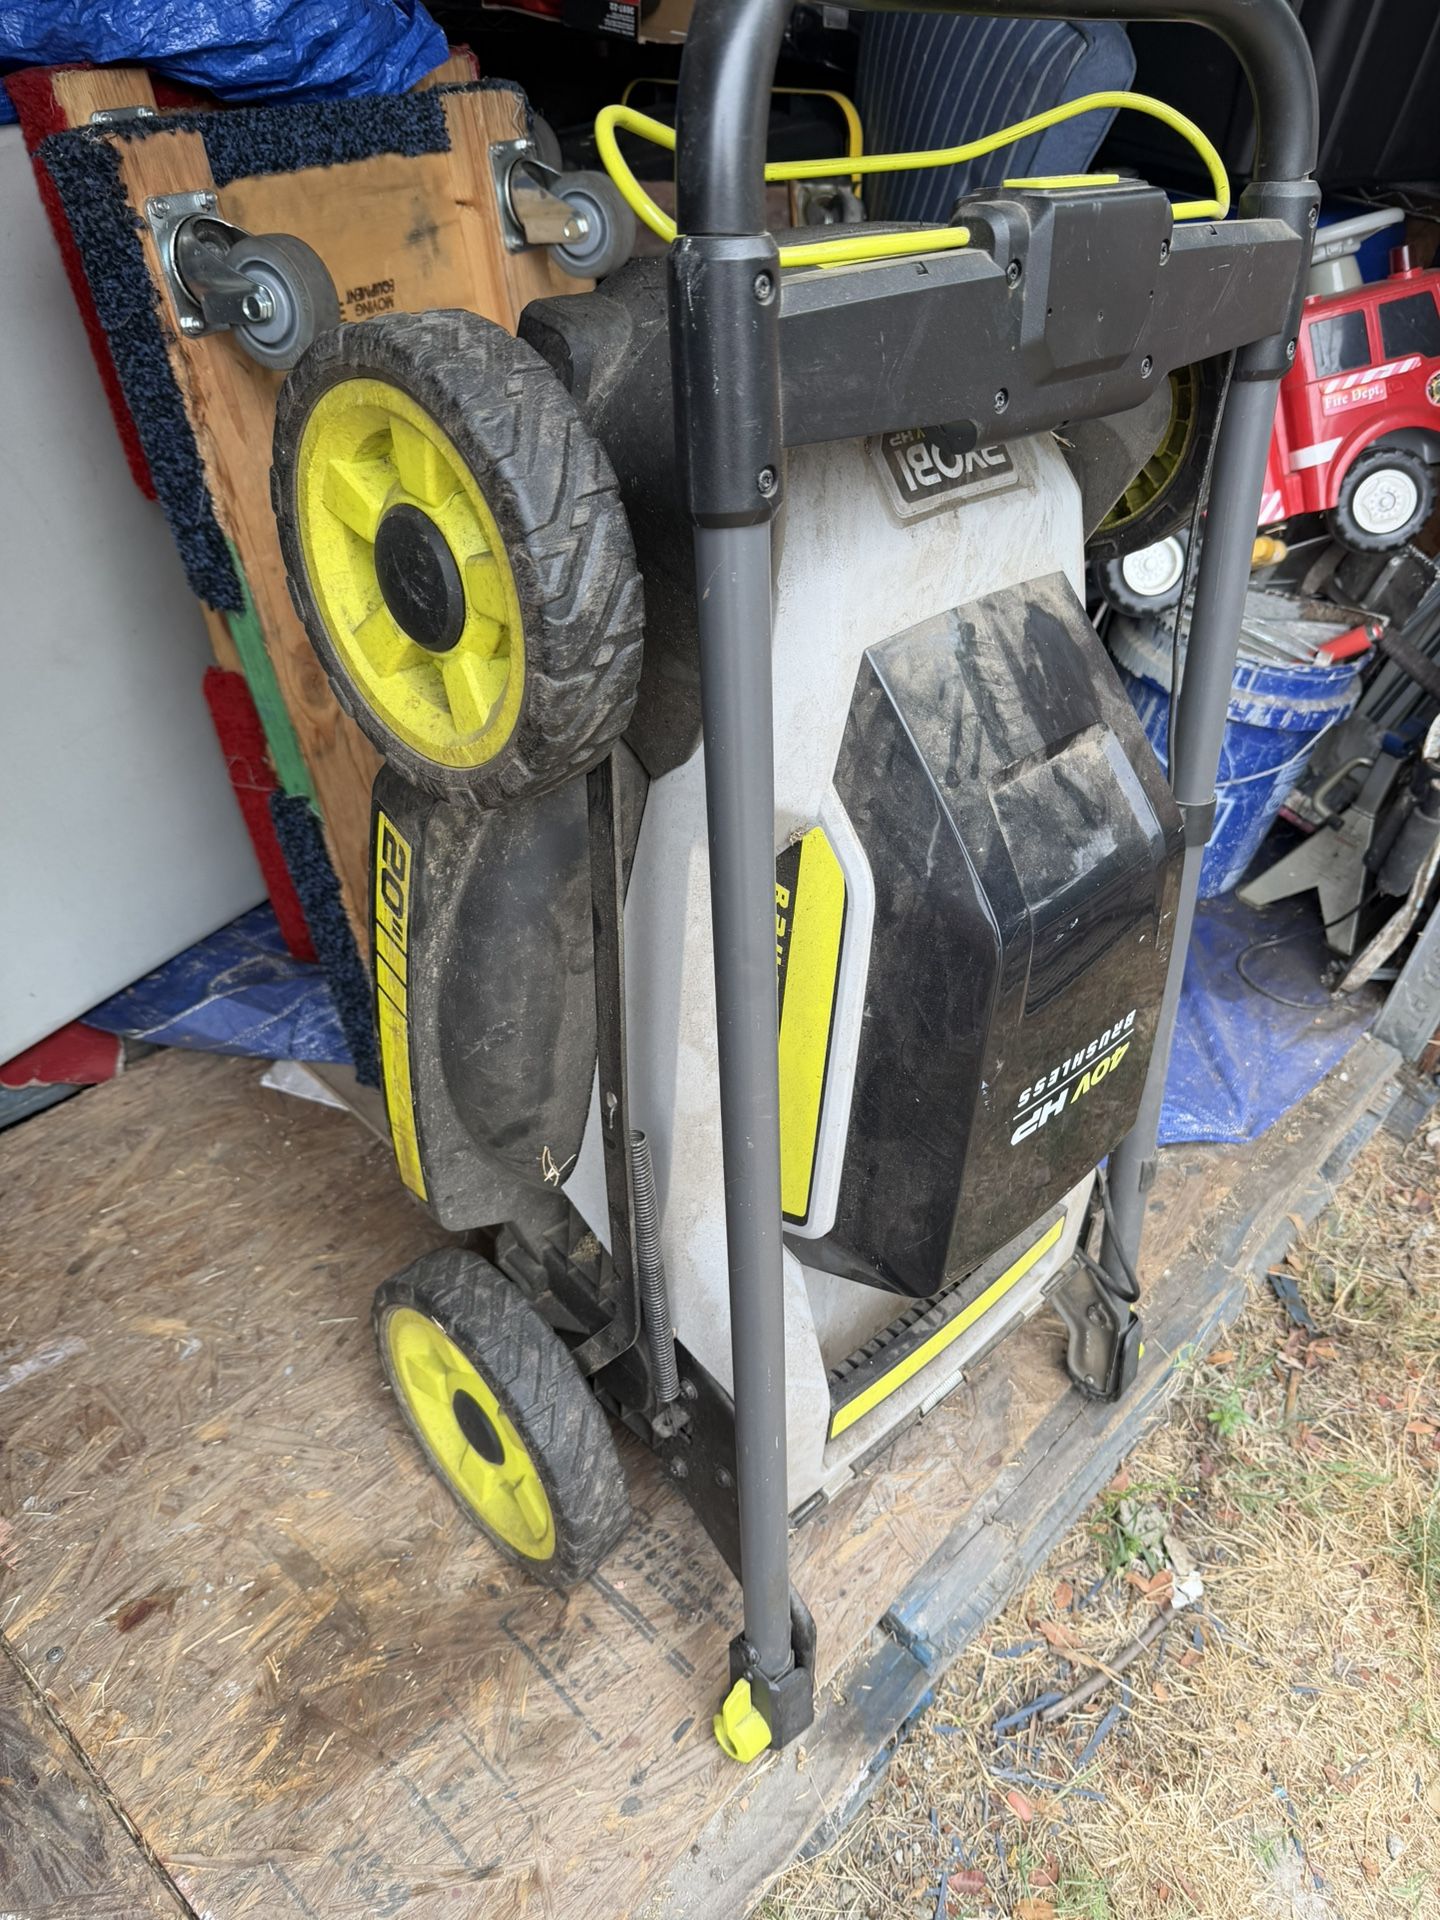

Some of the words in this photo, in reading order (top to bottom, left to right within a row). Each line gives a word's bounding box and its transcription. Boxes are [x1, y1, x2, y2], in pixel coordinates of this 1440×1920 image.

[346, 279, 395, 304] EQUIPMENT
[355, 295, 394, 317] MOVING
[1324, 394, 1348, 410] Fire
[1351, 385, 1384, 401] Dept.
[1017, 1008, 1137, 1109] BRUSHLESS
[1070, 1041, 1131, 1104] 40V
[1010, 1087, 1069, 1146] HP
